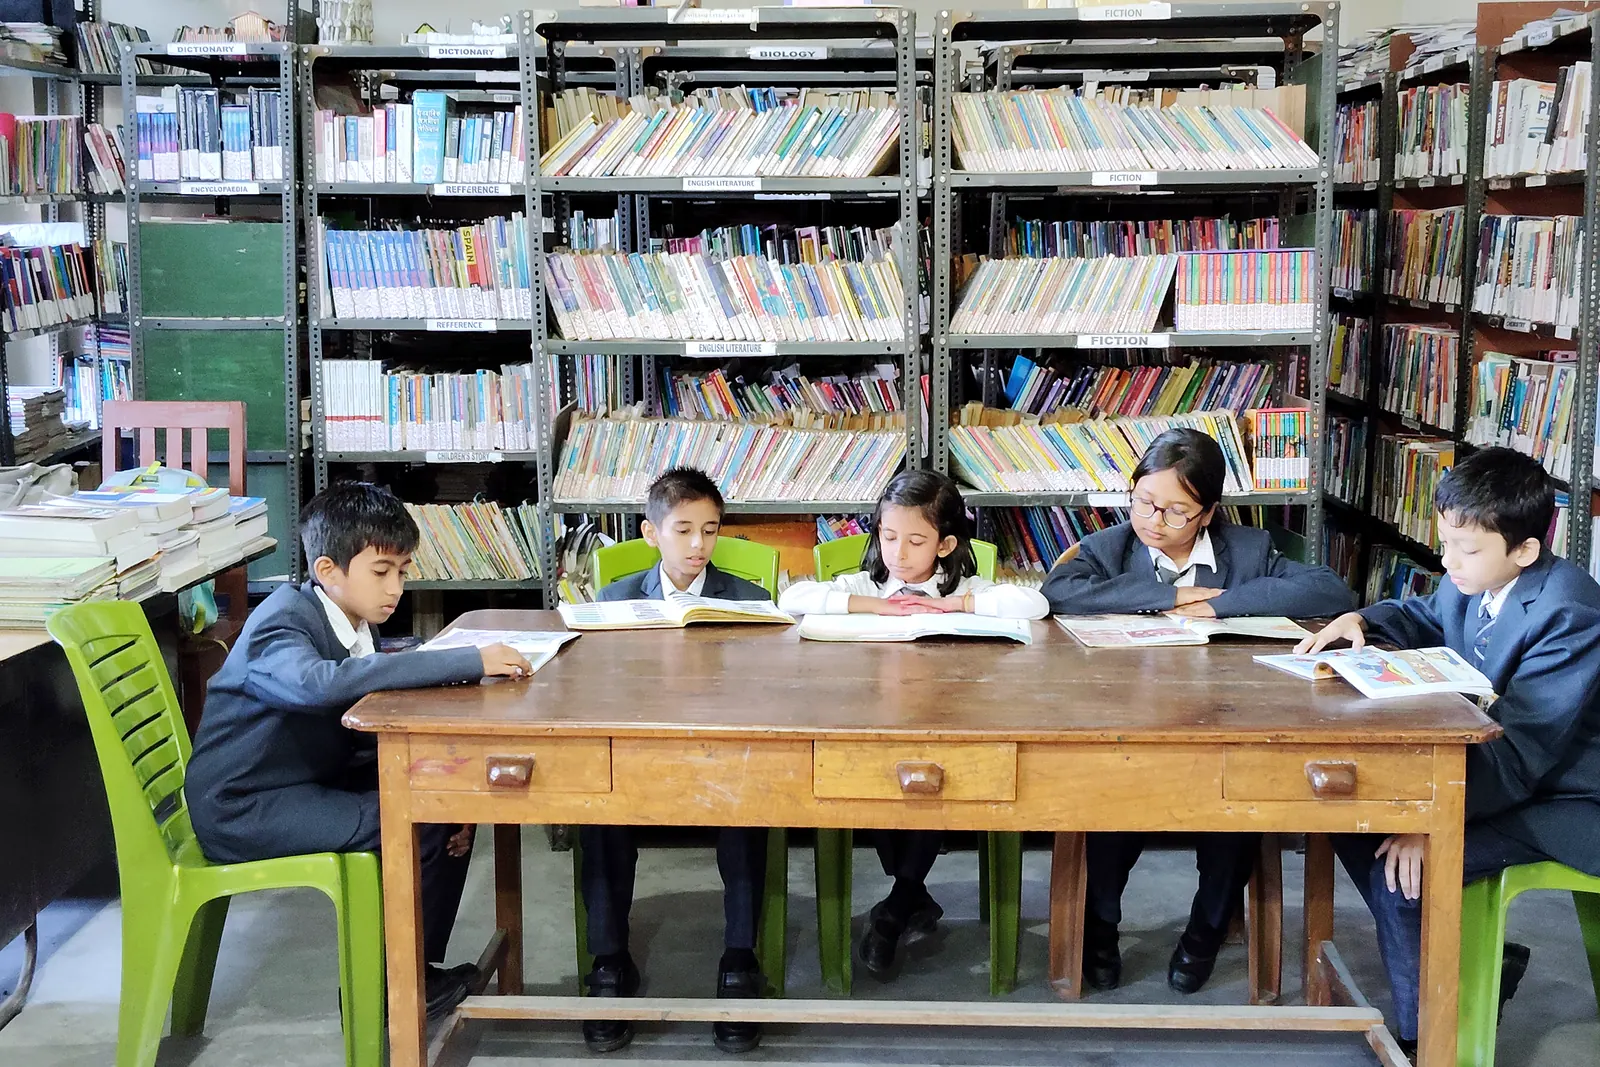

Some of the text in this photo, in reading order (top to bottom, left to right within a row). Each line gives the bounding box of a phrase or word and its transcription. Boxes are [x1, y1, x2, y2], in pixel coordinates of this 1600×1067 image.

[1105, 9, 1142, 17] FICTION
[438, 48, 495, 56] DICTIONARY
[446, 186, 499, 194] REFFERENCE
[463, 230, 475, 262] SPAIN
[1091, 336, 1149, 345] FICTION
[699, 343, 762, 352] ENGLISH LITERATURE
